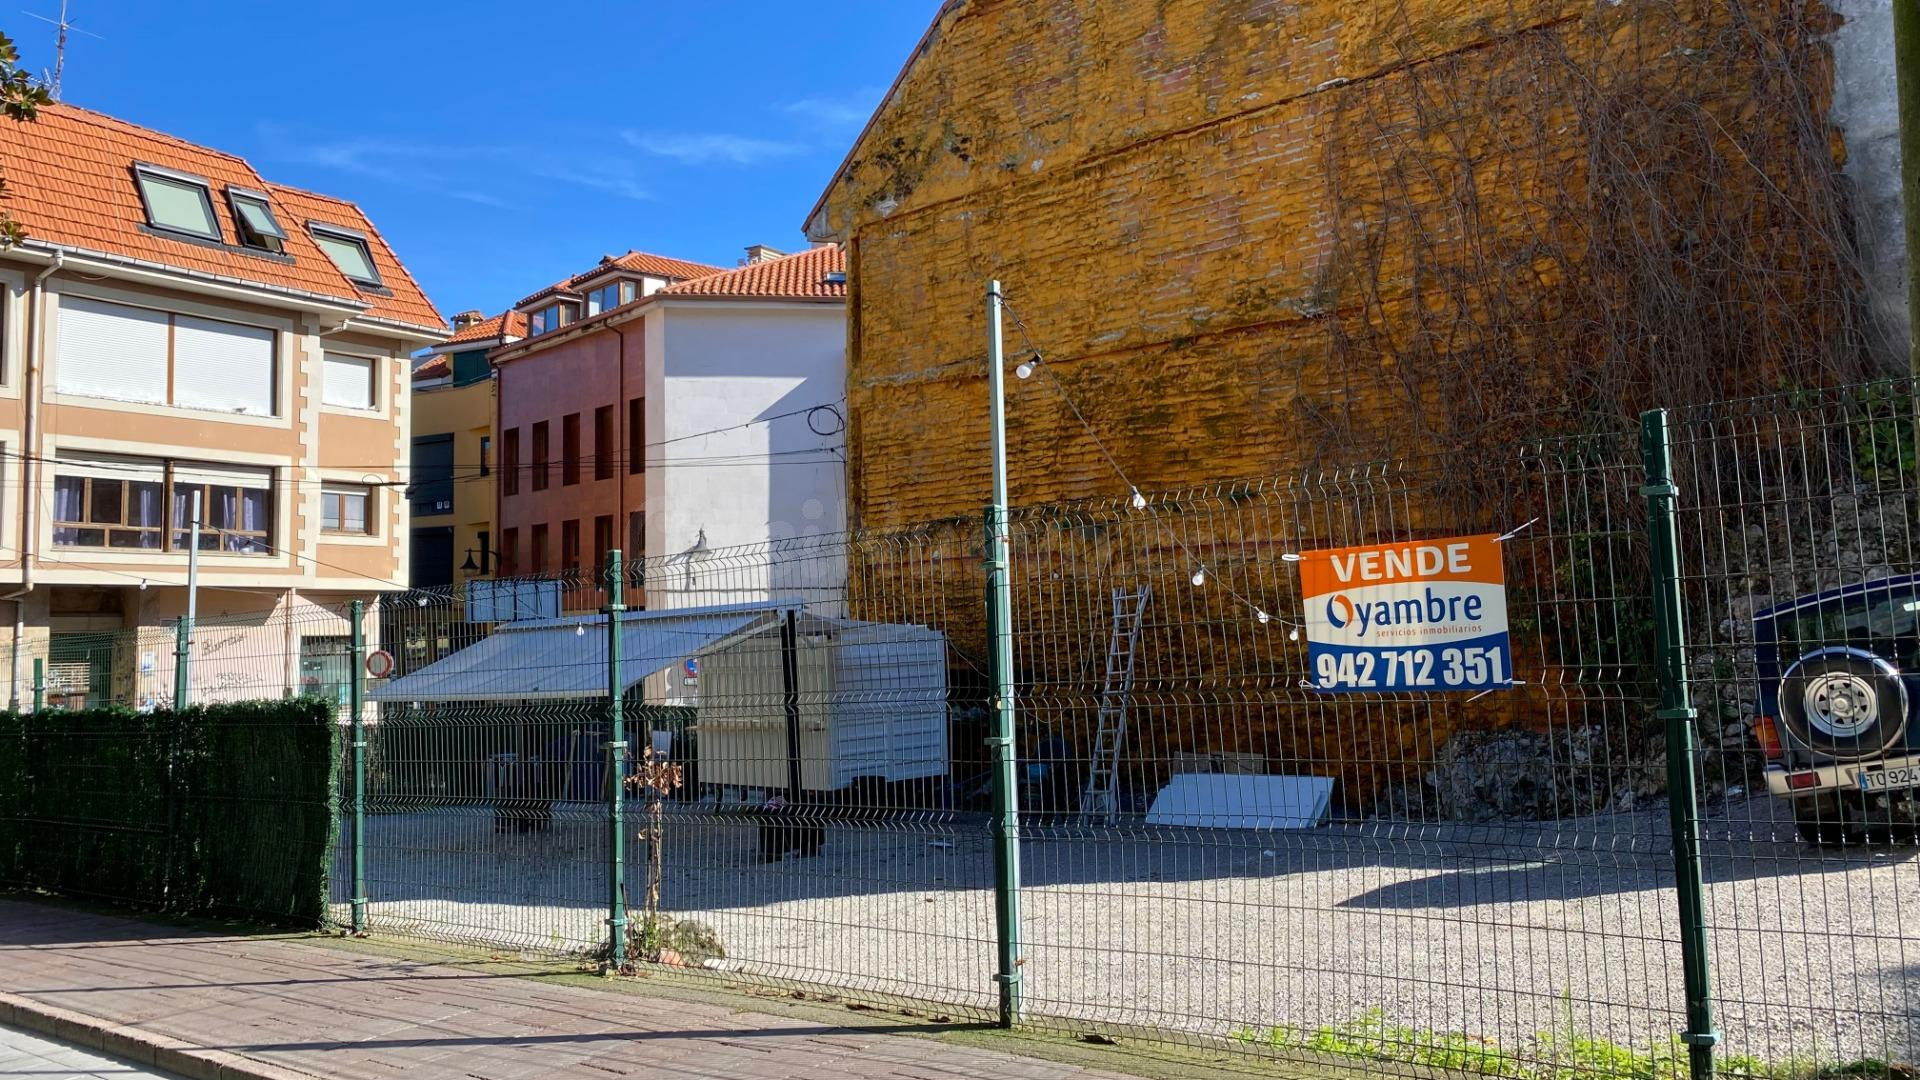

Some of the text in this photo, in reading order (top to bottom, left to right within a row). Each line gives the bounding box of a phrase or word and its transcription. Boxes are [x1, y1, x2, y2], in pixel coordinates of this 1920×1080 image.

[1330, 543, 1472, 582] VENDE
[1376, 624, 1482, 638] servicios inmobiliarios
[1316, 646, 1503, 689] 942 712 351
